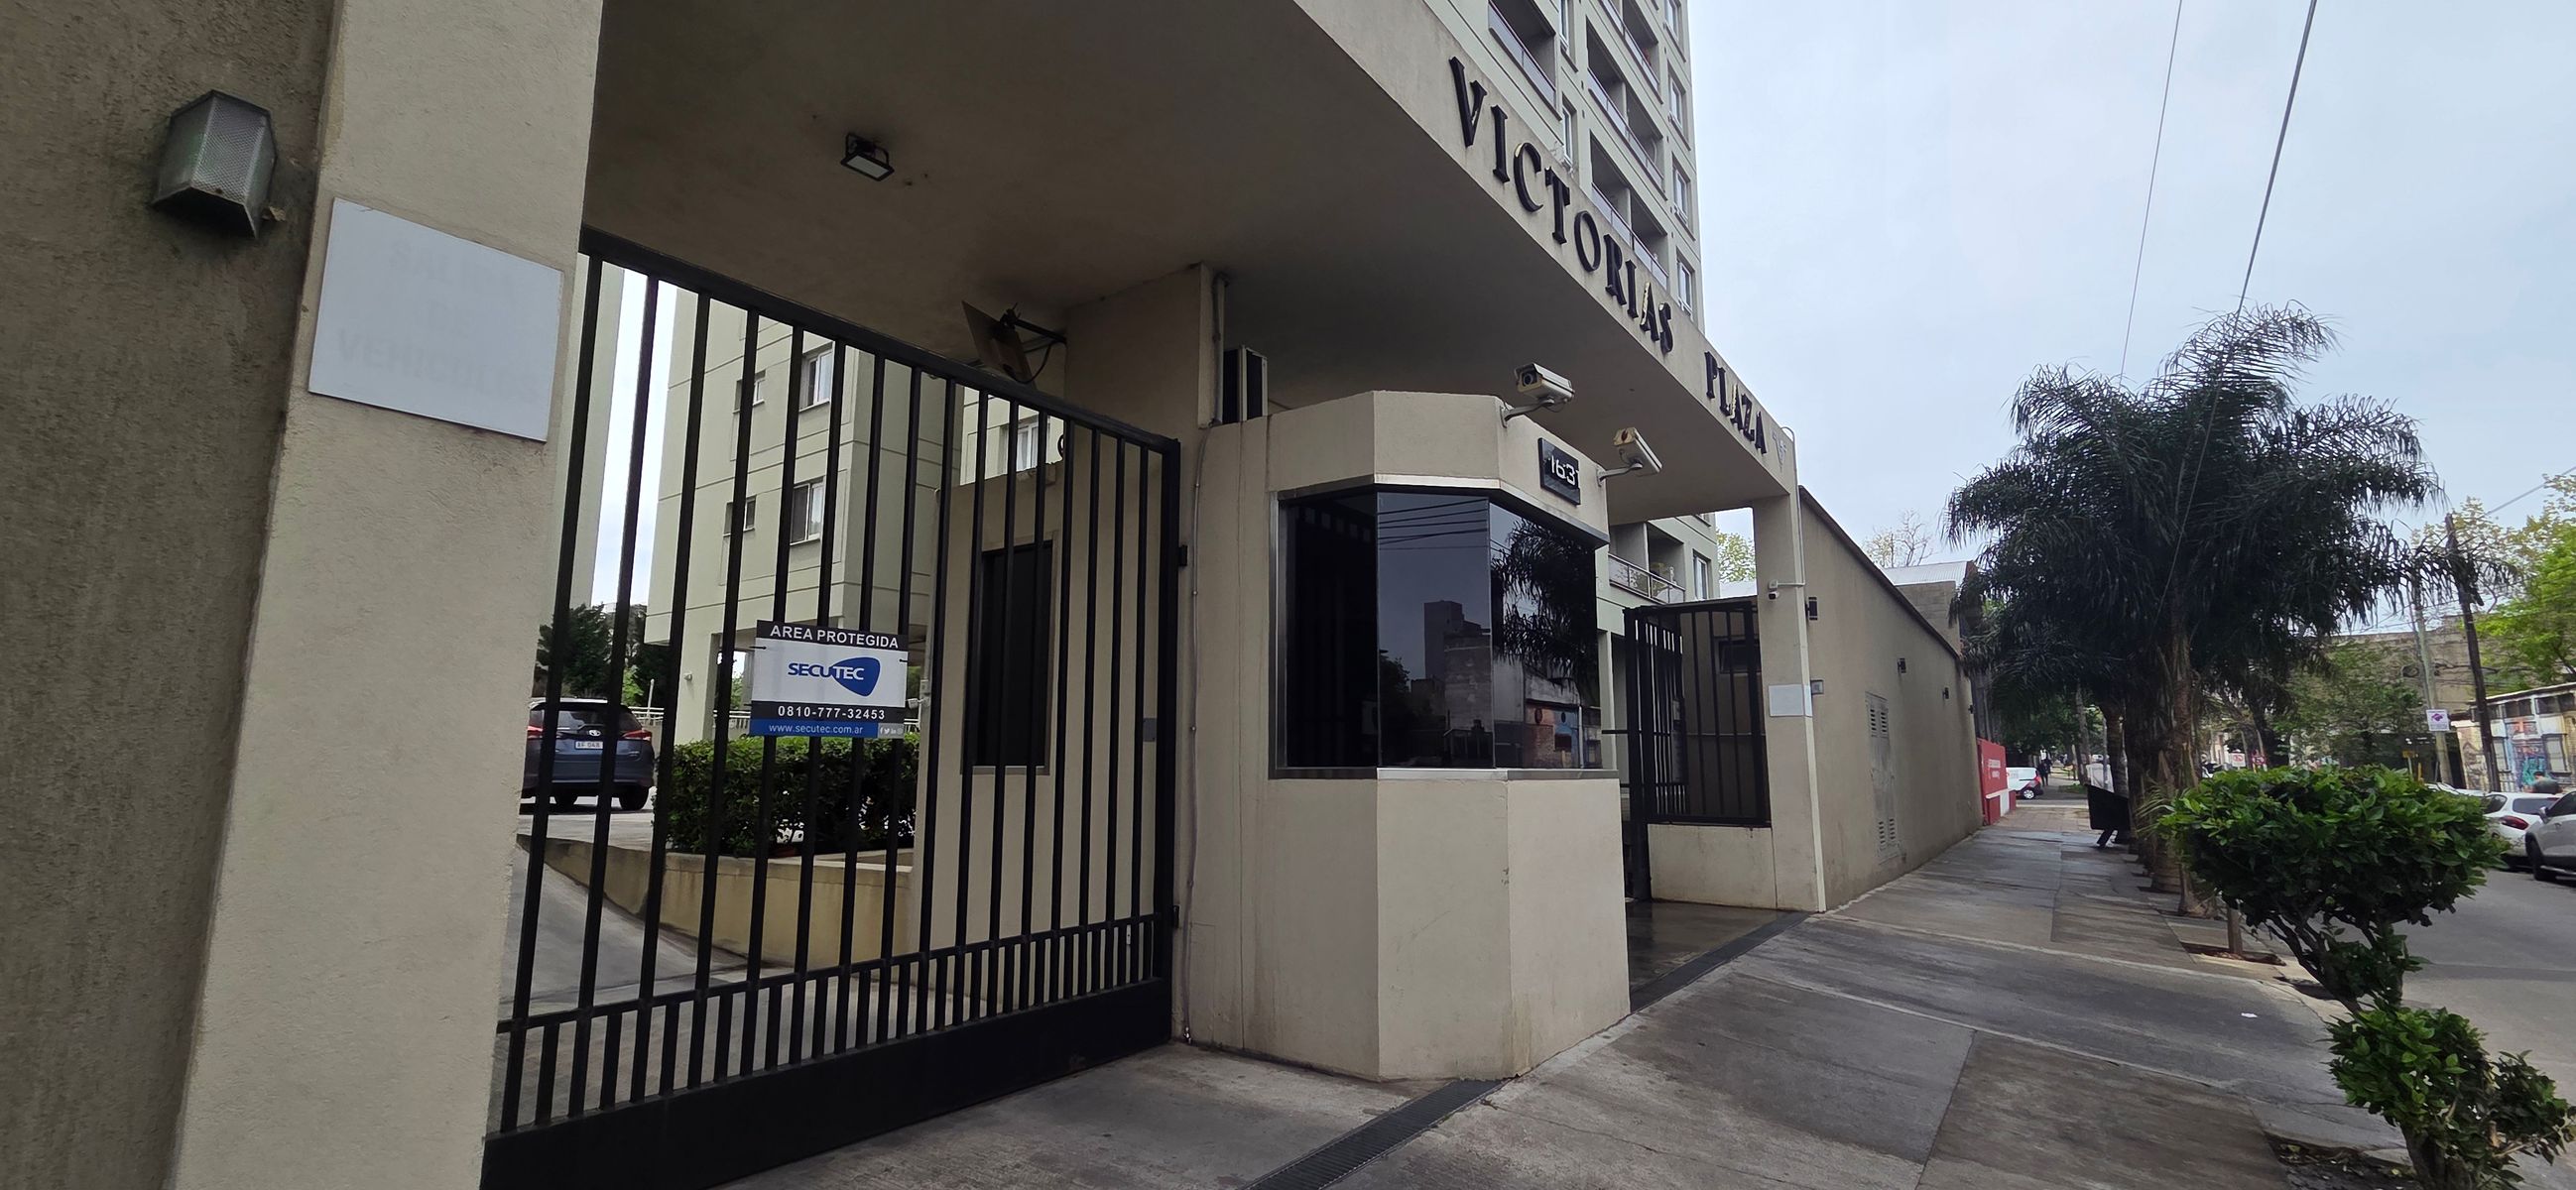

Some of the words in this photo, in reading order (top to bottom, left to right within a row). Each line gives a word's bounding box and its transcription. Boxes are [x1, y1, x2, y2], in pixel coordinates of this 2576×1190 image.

[1448, 56, 1674, 354] VICTORIAS
[1704, 350, 1767, 454] PLAZA
[770, 625, 813, 641] AREA
[816, 630, 899, 649] PROTEGIDA
[788, 662, 865, 681] SECUTEC
[778, 705, 886, 720] 0810-777-32453
[769, 723, 864, 734] www.secutec.com.ar
